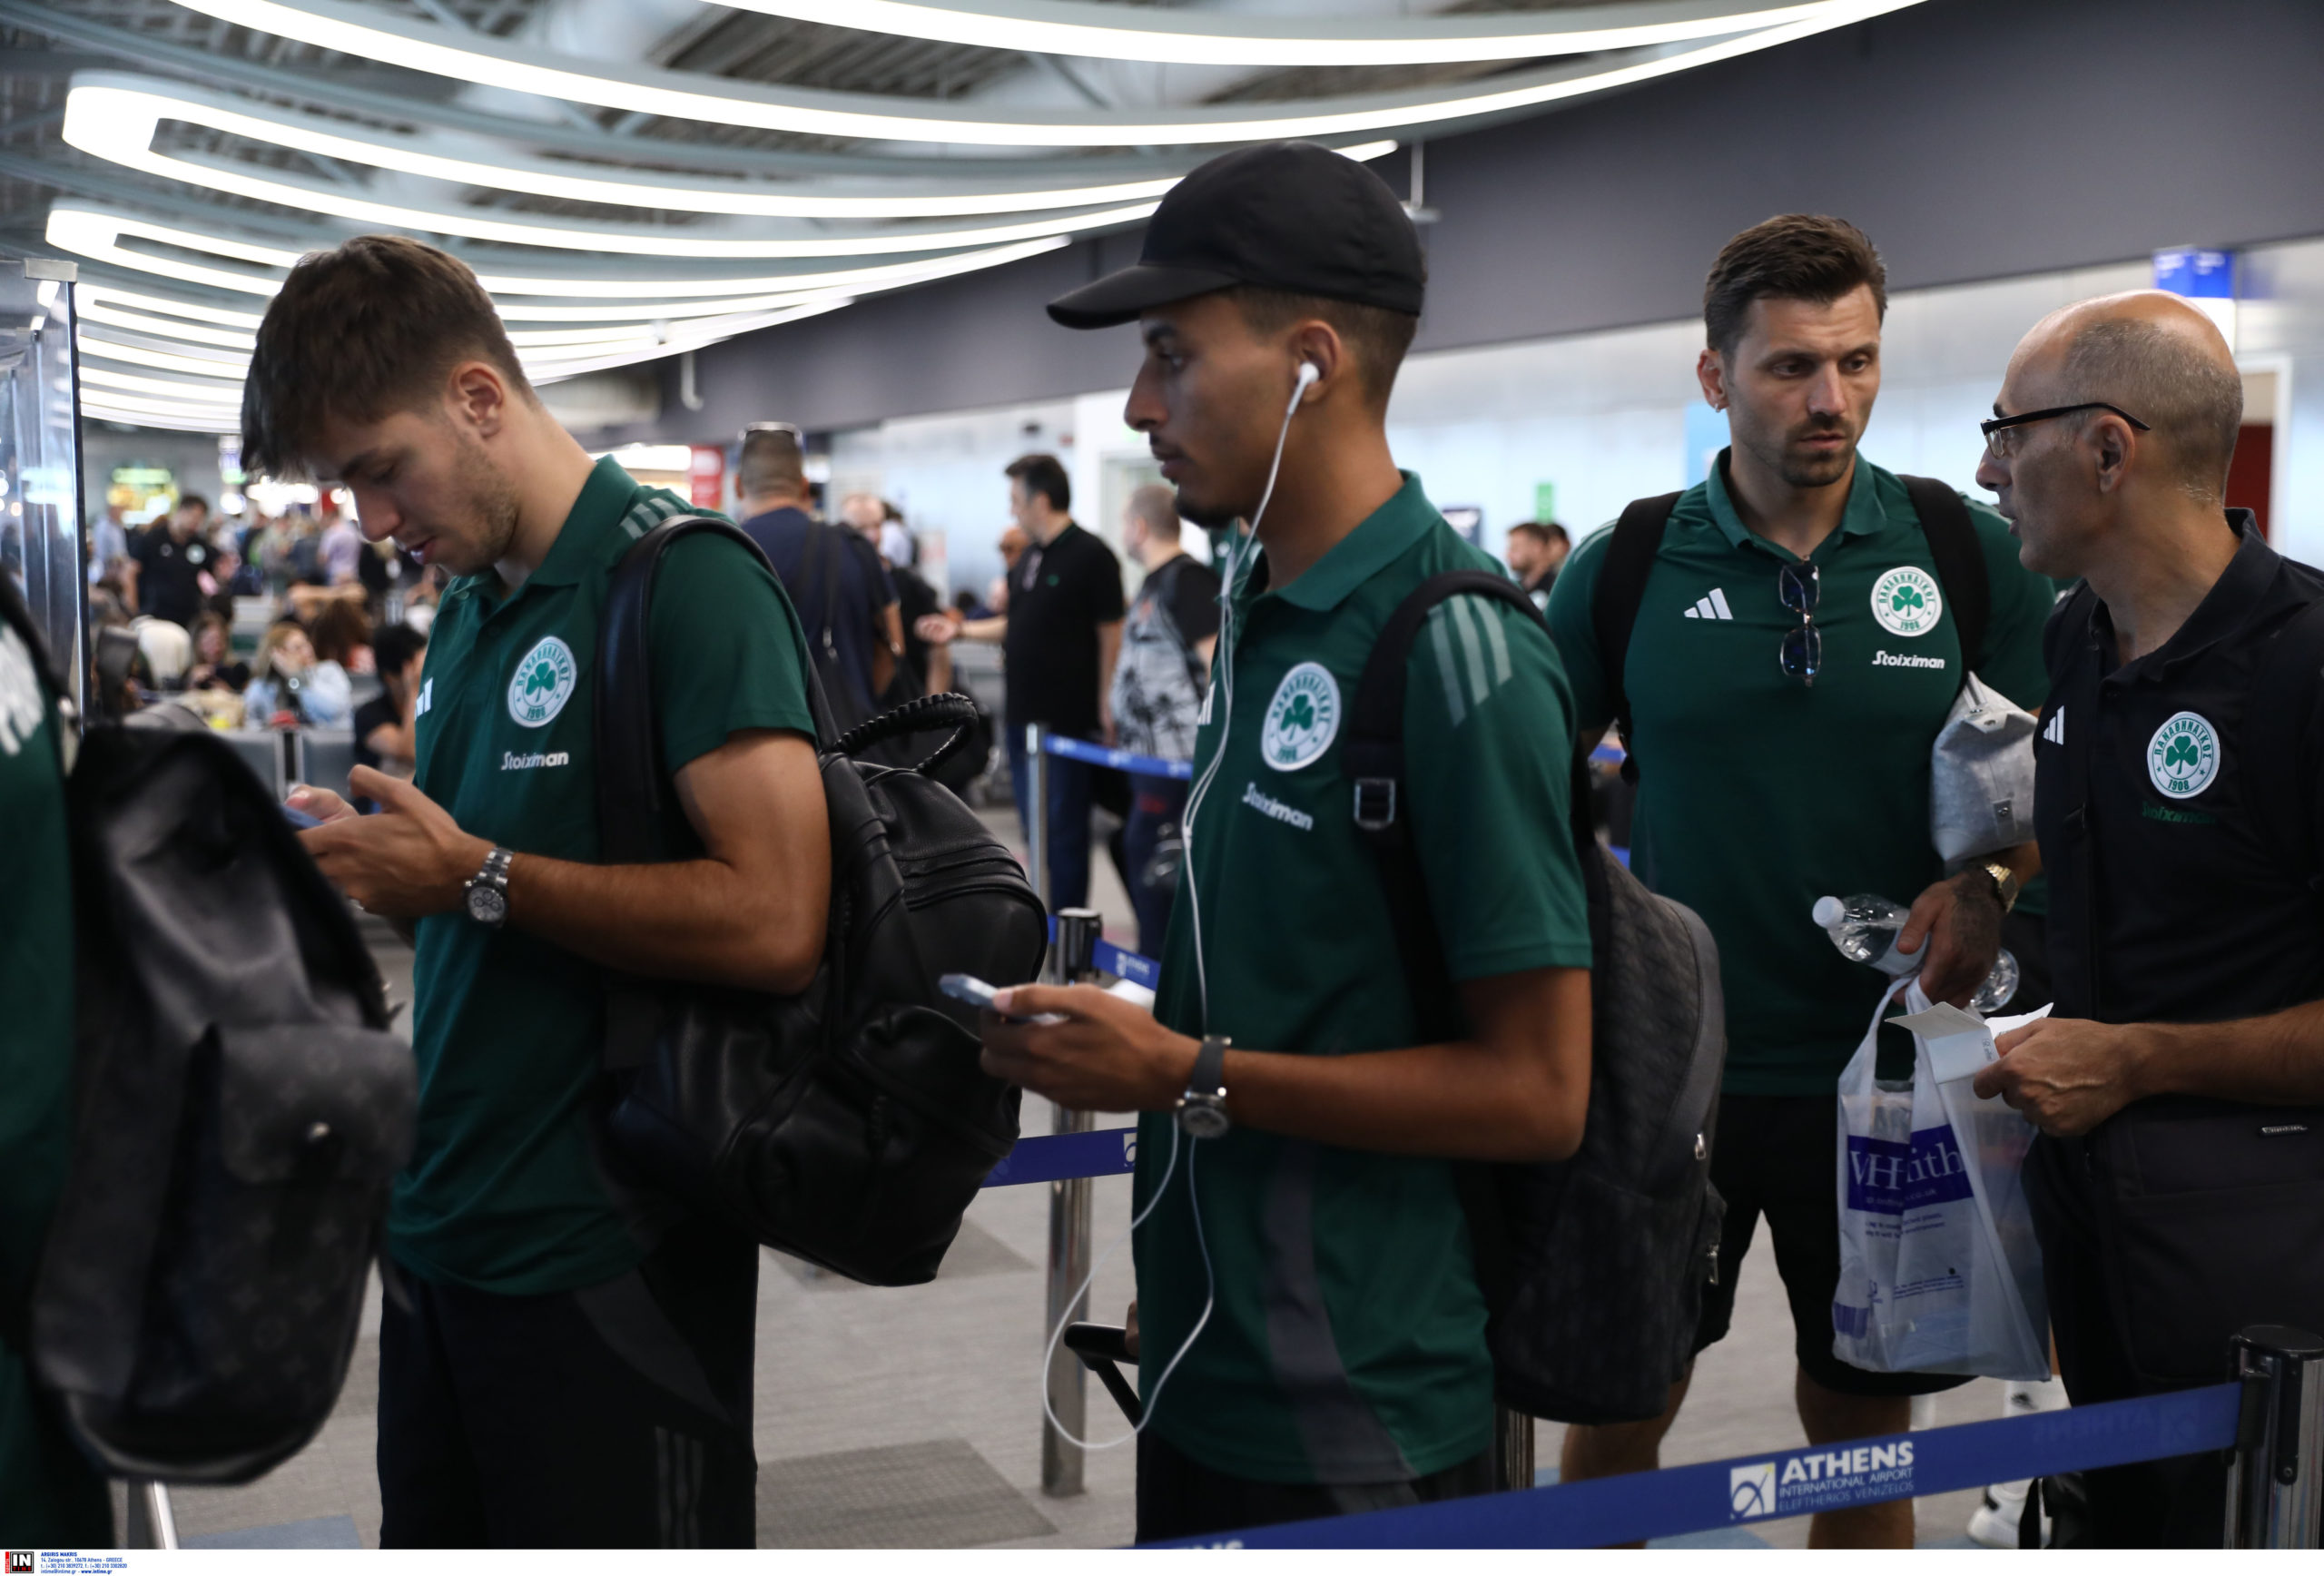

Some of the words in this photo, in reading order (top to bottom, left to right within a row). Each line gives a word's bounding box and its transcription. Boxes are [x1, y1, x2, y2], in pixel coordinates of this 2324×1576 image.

[1900, 620, 1921, 631] 1908
[1871, 650, 1945, 669] Stoiximan
[527, 705, 547, 720] 1908
[500, 751, 569, 771] Stoiximan
[2167, 779, 2191, 792] 1908
[1780, 1441, 1915, 1485] ATHENS
[1779, 1475, 1866, 1498] INTERNATIONAL
[1869, 1467, 1915, 1484] AIRPORT
[1778, 1491, 1852, 1512] ELEFTHERIOS
[1855, 1481, 1915, 1499] VENIZELOS
